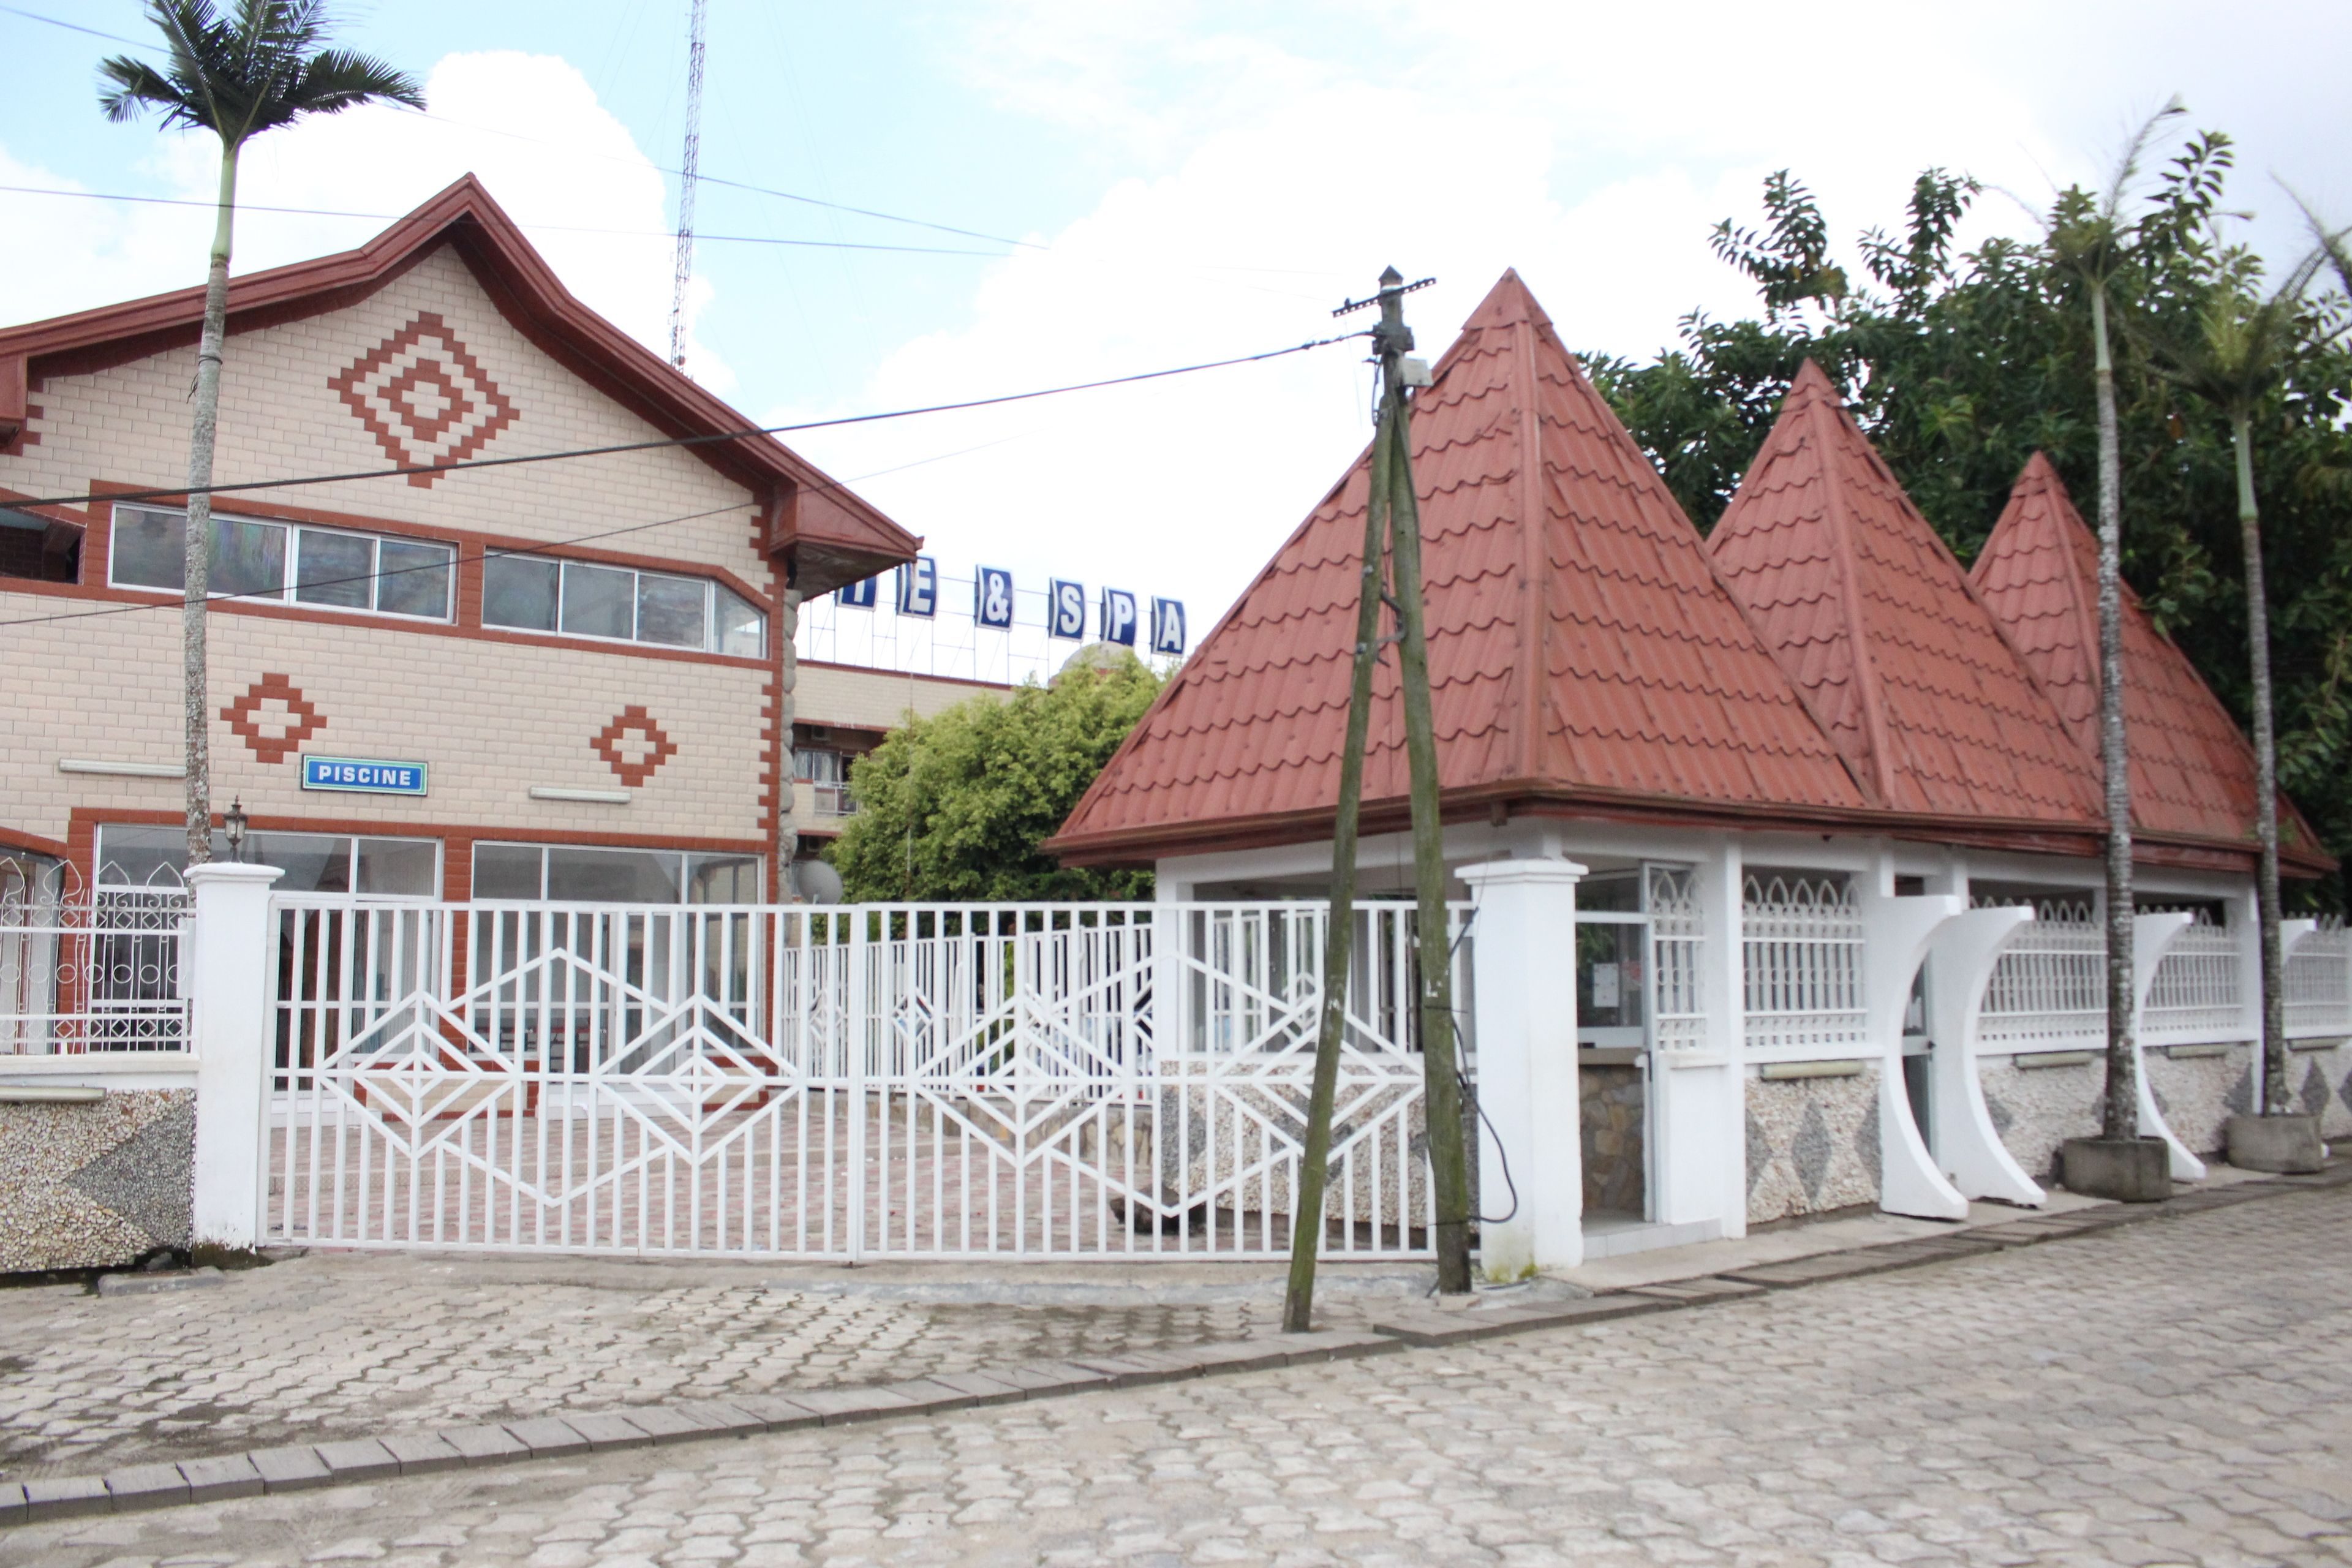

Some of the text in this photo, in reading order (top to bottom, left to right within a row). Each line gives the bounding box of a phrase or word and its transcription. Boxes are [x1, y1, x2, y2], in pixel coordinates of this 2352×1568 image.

[986, 573, 1009, 622] &
[1060, 585, 1182, 650] SPA
[318, 765, 411, 786] PISCINE
